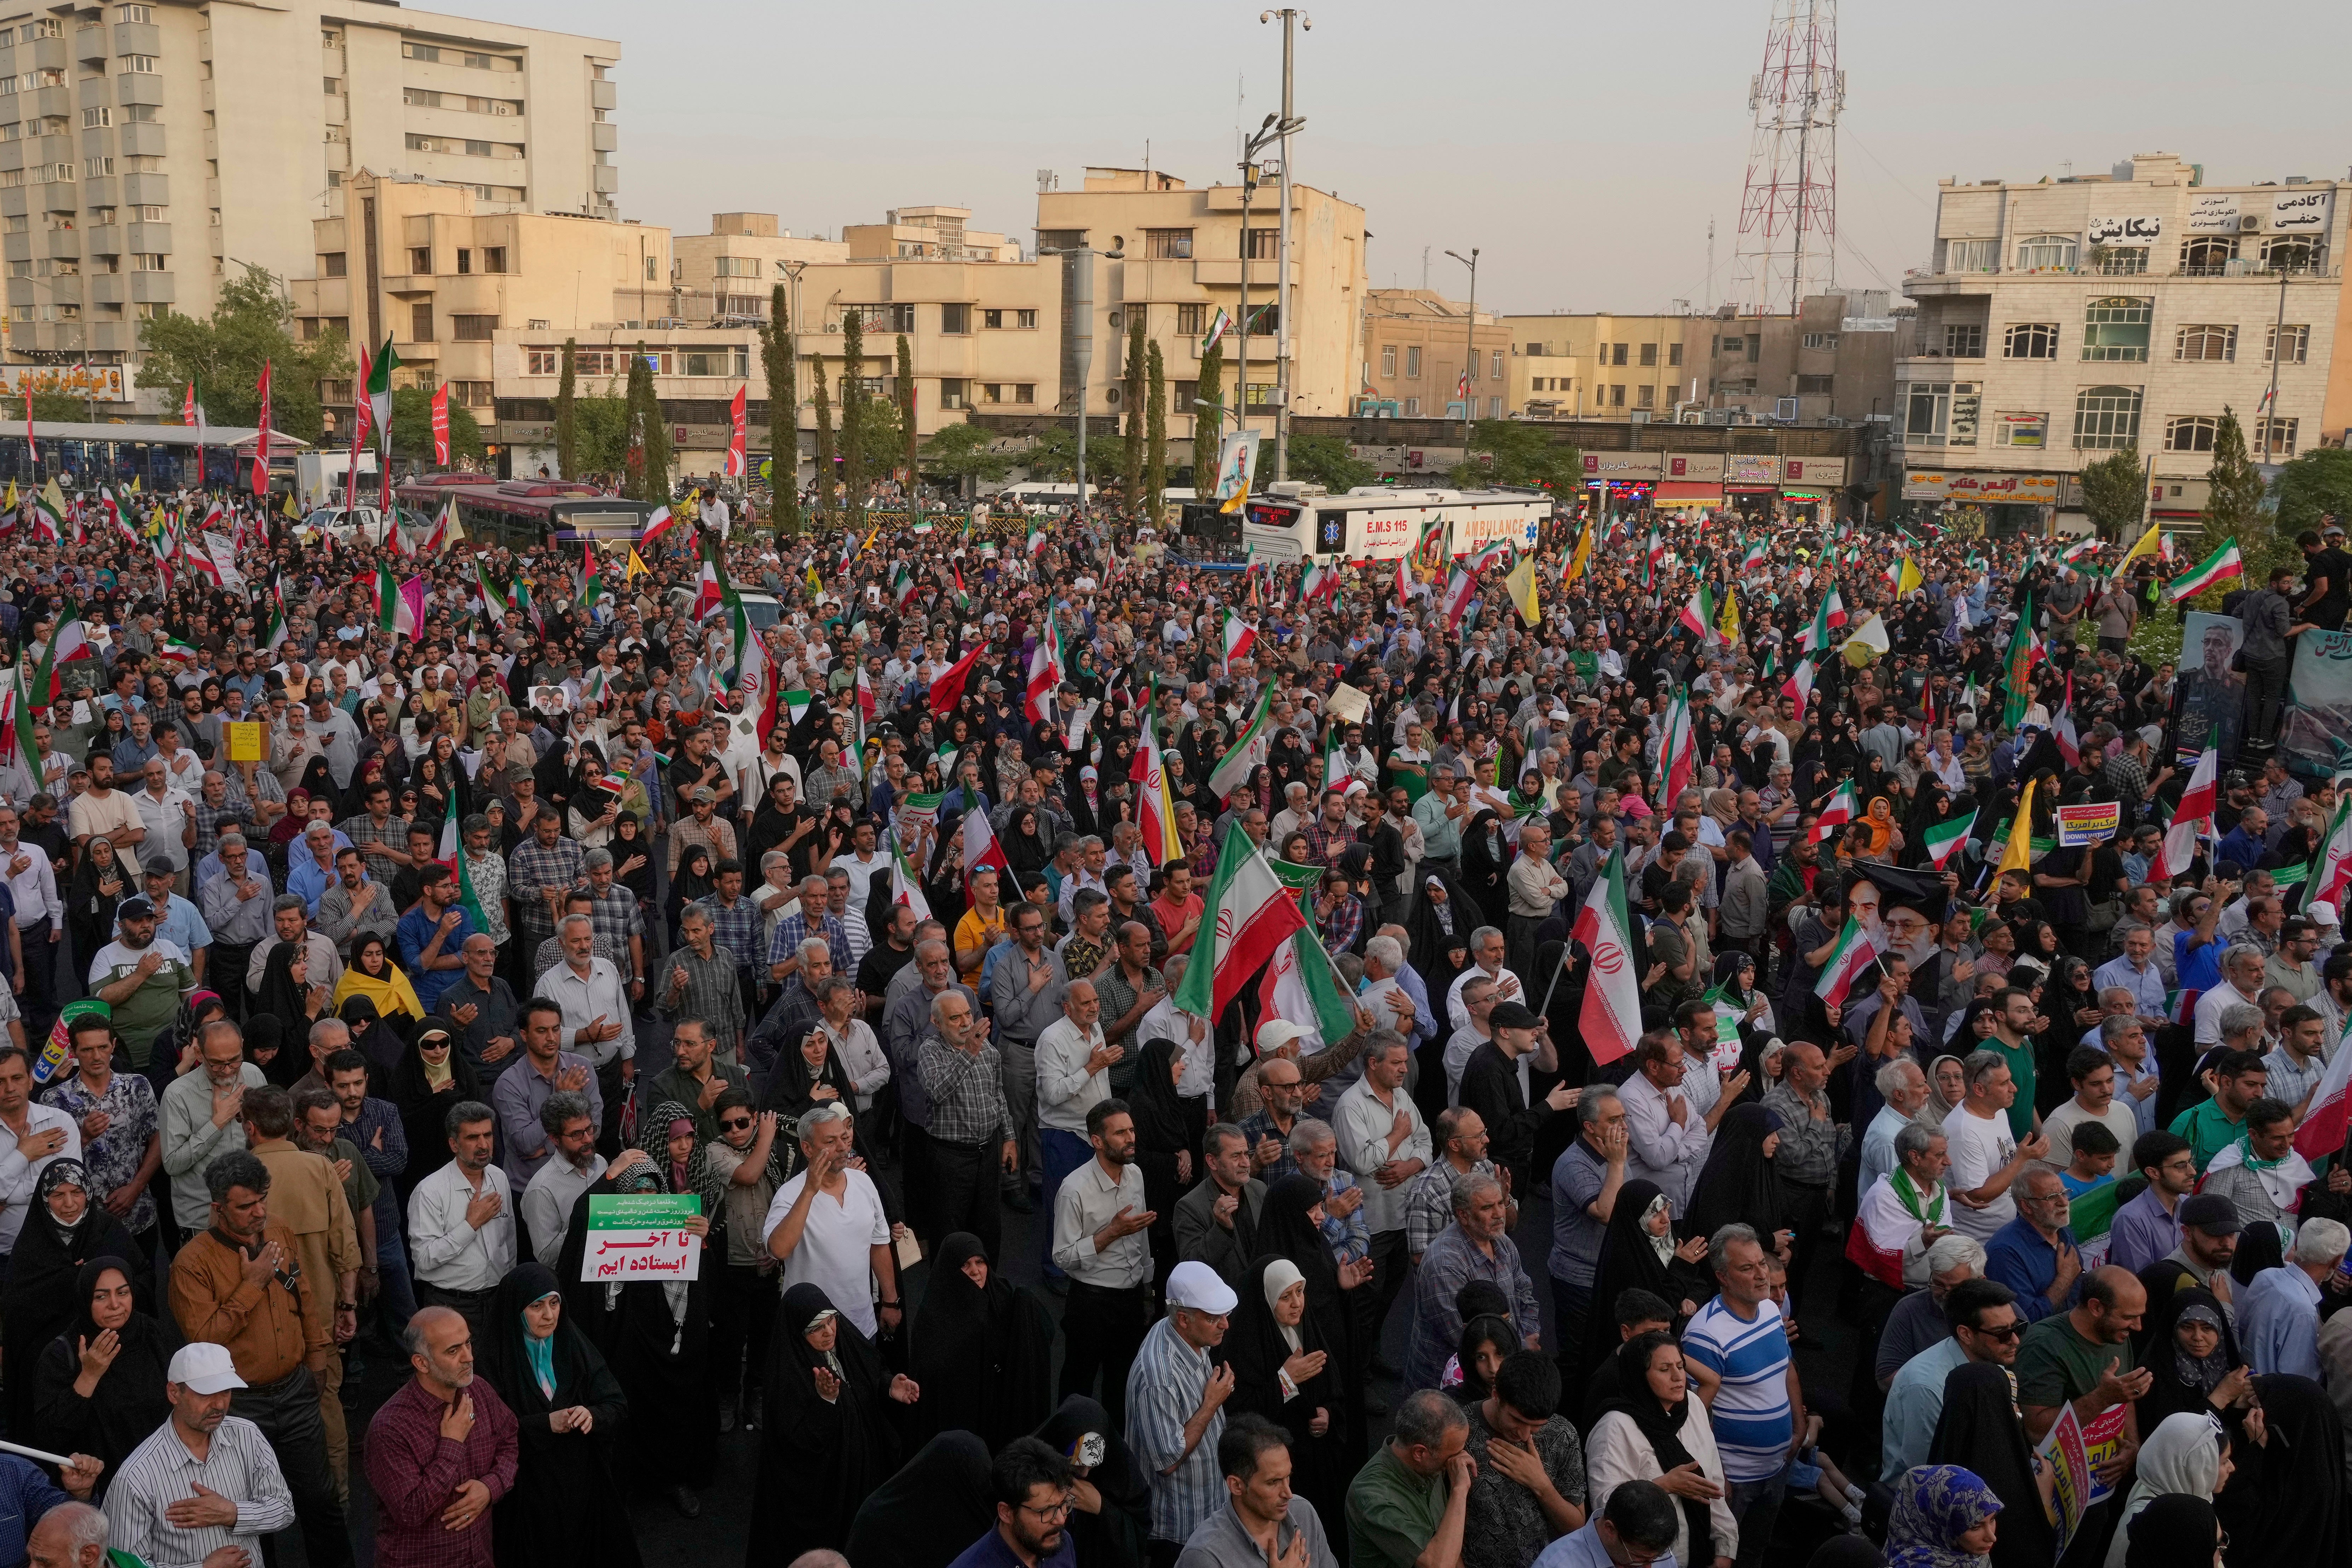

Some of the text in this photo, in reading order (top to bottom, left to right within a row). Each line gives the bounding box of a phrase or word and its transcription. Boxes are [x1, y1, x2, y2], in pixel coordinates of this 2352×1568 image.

[2201, 197, 2229, 206] آموزش
[2277, 193, 2329, 211] آکادمی
[2191, 219, 2226, 227] کامپیوتری
[2275, 215, 2321, 228] حنفی
[2089, 217, 2160, 244] نیکایش
[2109, 298, 2128, 307] CD
[687, 428, 708, 438] گلچین
[1425, 455, 1438, 465] آریا
[1598, 460, 1628, 471] گلریزان
[1736, 457, 1757, 467] کتاب
[1689, 463, 1705, 472] روز
[1739, 468, 1769, 479] پارسیان
[1816, 469, 1841, 479] خیری
[1949, 478, 1978, 490] کتاب
[1982, 478, 2017, 492] آژانس
[1944, 491, 2055, 503] فروشگاه اینترنتی کتاب
[1254, 506, 1290, 516] AMBULANCE
[1367, 520, 1407, 533] E.M.S 115
[1465, 519, 1524, 537] AMBULANCE
[1364, 539, 1376, 548] تهران
[1389, 538, 1407, 547] اورژانس
[2066, 819, 2091, 830] آمریکا
[1729, 1042, 1737, 1053] تا
[596, 1231, 691, 1255] تا آخر
[598, 1254, 687, 1278] ایستاده ایم
